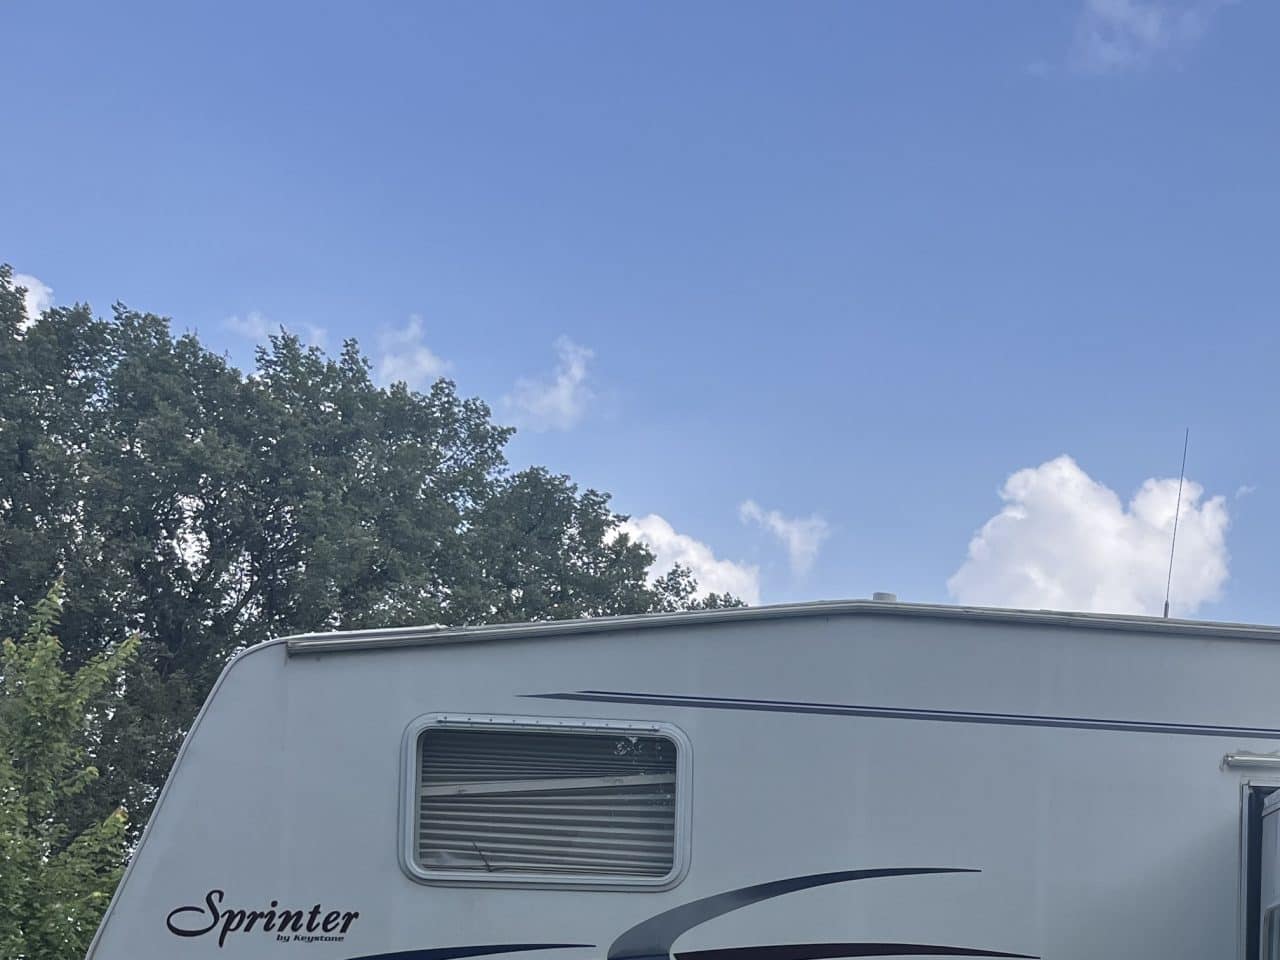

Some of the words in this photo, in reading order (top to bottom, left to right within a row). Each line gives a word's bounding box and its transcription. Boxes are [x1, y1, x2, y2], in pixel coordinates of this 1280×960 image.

[166, 889, 360, 948] Sprinter
[276, 933, 291, 943] by
[293, 934, 345, 943] Keystone
